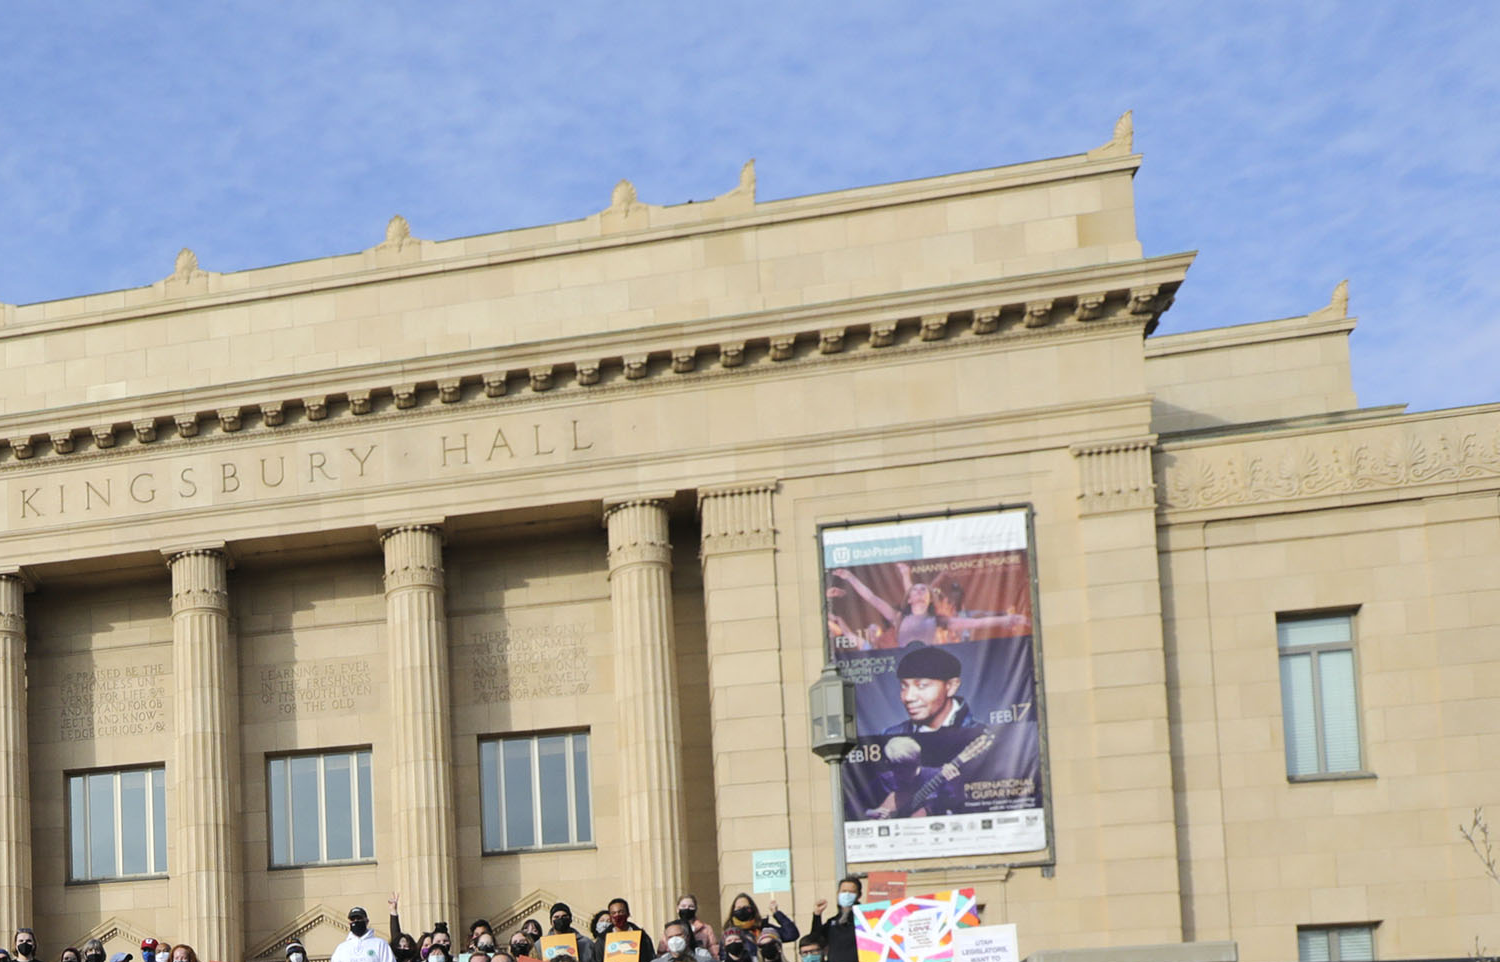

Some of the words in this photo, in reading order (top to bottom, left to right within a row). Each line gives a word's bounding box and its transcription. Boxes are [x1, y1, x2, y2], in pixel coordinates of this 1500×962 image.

[20, 444, 376, 519] KINGSBURY
[439, 420, 594, 467] HALL
[755, 868, 787, 877] LOVE
